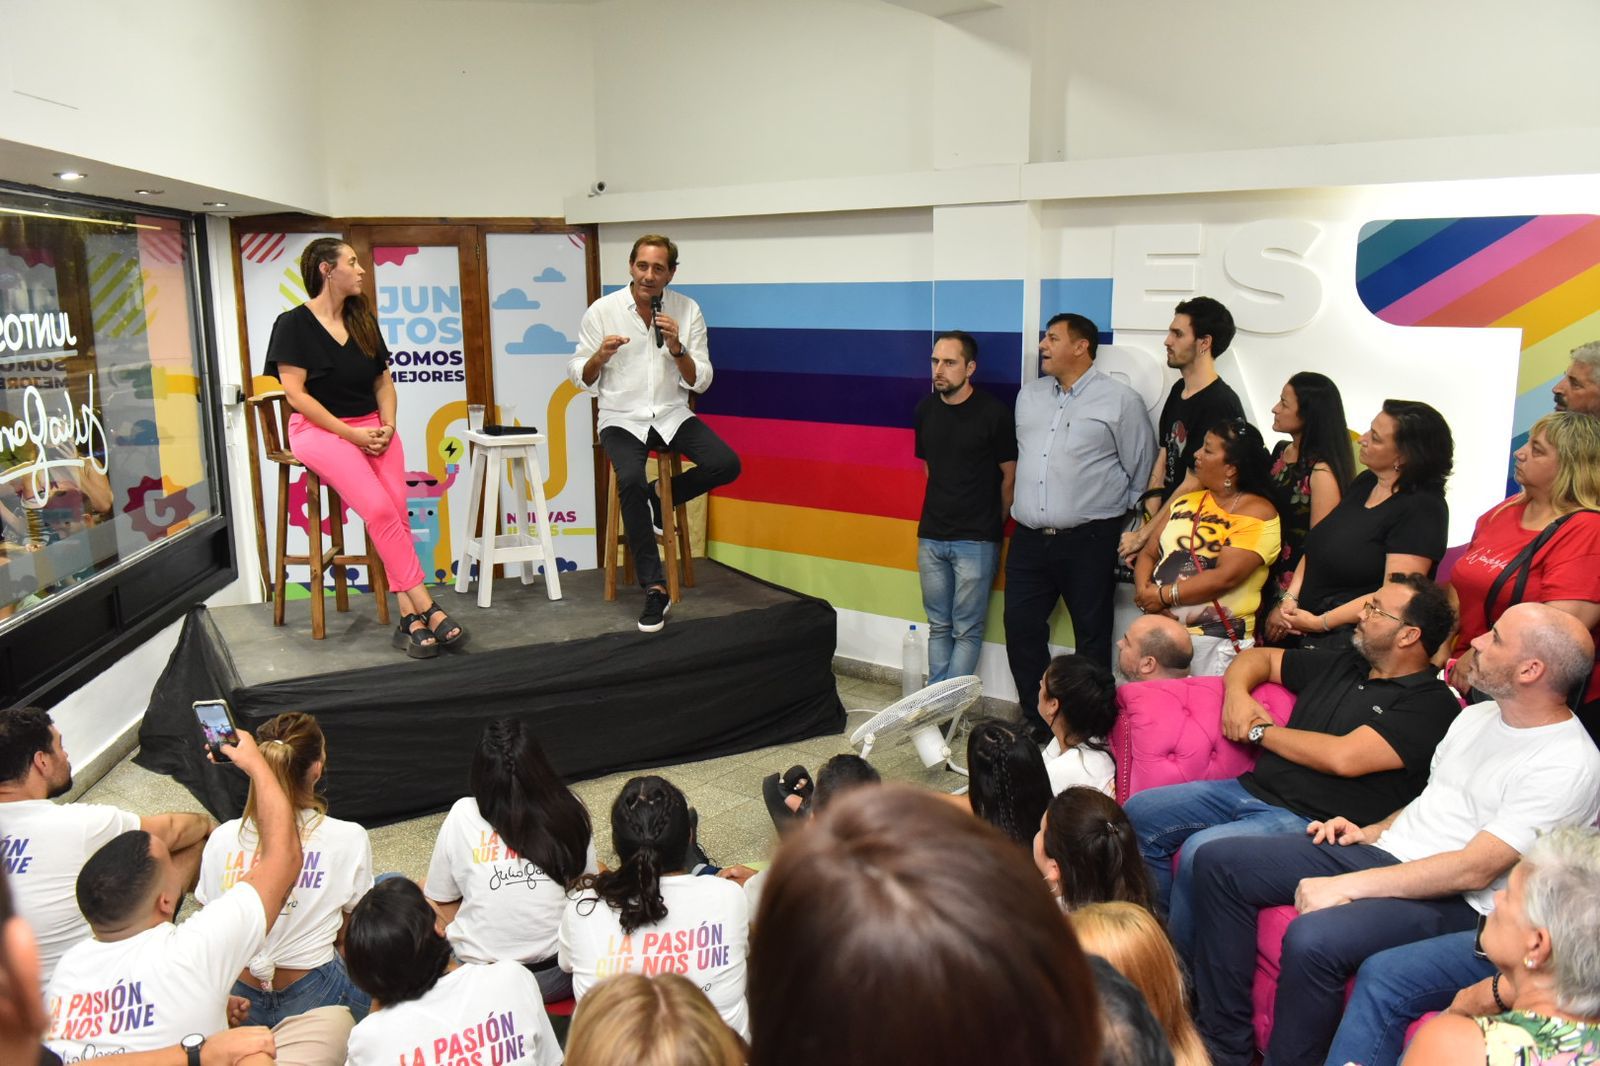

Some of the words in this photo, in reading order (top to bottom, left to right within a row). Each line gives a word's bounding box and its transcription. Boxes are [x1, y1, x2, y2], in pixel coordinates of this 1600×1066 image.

[1111, 220, 1322, 335] ES
[378, 286, 460, 313] JUN
[379, 316, 462, 345] TOS
[642, 920, 723, 955] PASIÓN
[642, 953, 689, 977] NOS
[697, 945, 730, 971] UNE
[67, 978, 142, 1017] PASIÓN
[61, 1015, 103, 1041] NOS
[109, 1003, 155, 1035] UNE
[433, 1010, 515, 1065] PASIÓN
[490, 1034, 526, 1066] UNE
